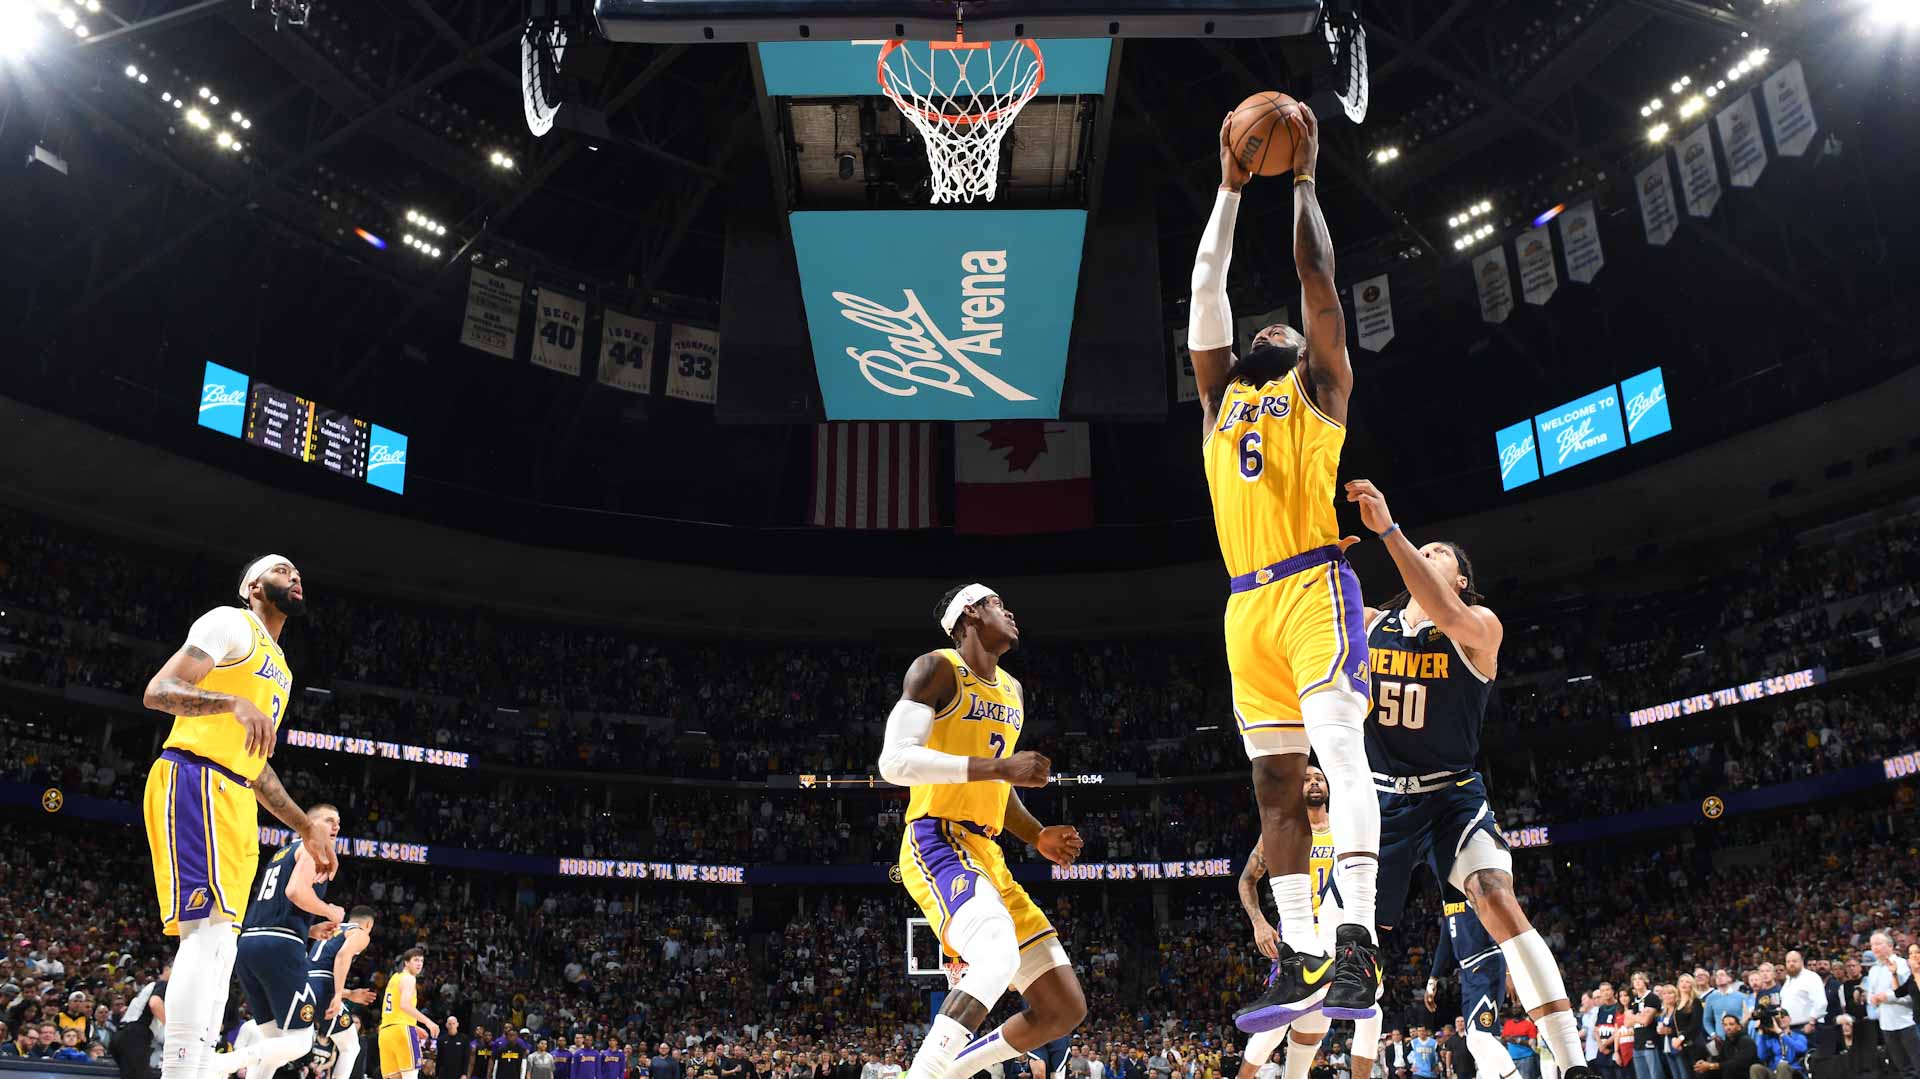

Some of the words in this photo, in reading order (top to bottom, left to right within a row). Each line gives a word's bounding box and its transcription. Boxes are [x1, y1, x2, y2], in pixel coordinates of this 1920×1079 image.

[950, 249, 1008, 356] Arena
[540, 322, 576, 350] 40
[832, 288, 982, 399] Ball
[608, 342, 643, 369] 44
[679, 353, 712, 380] 33
[201, 383, 246, 408] Ball
[268, 397, 287, 410] Russell
[1626, 383, 1666, 427] Ball
[264, 406, 288, 420] Vanderbilt
[326, 419, 341, 430] Porter
[1218, 395, 1290, 432] LKRS
[1541, 404, 1597, 432] WELCOME
[1598, 396, 1615, 410] TO
[266, 428, 281, 438] James
[1556, 417, 1594, 457] Ball
[1574, 433, 1608, 452] Arena
[368, 445, 406, 466] Ball
[1239, 431, 1264, 479] 6
[1500, 435, 1536, 474] Ball
[962, 693, 1021, 731] LAKERS
[1378, 681, 1427, 730] 50
[1629, 700, 1682, 728] NOBODY
[1682, 694, 1714, 715] SITS
[1739, 682, 1764, 702] WE
[1765, 670, 1816, 696] SCORE
[286, 728, 344, 751] NOBODY
[345, 737, 375, 756] SITS
[403, 744, 424, 762] WE
[426, 748, 470, 768] SCORE
[1077, 774, 1103, 784] 10:54
[354, 838, 378, 858] WE
[380, 842, 429, 862] SCORE
[1502, 828, 1550, 848] SCORE
[258, 865, 282, 900] 15
[560, 858, 616, 877] NOBODY
[616, 862, 646, 878] SITS
[676, 864, 698, 881] WE
[700, 866, 744, 882] SCORE
[1052, 864, 1104, 880] NOBODY
[1106, 864, 1136, 880] SITS
[1163, 862, 1184, 878] WE
[1187, 858, 1232, 877] SCORE
[1317, 867, 1324, 895] 1
[1450, 916, 1457, 938] 5
